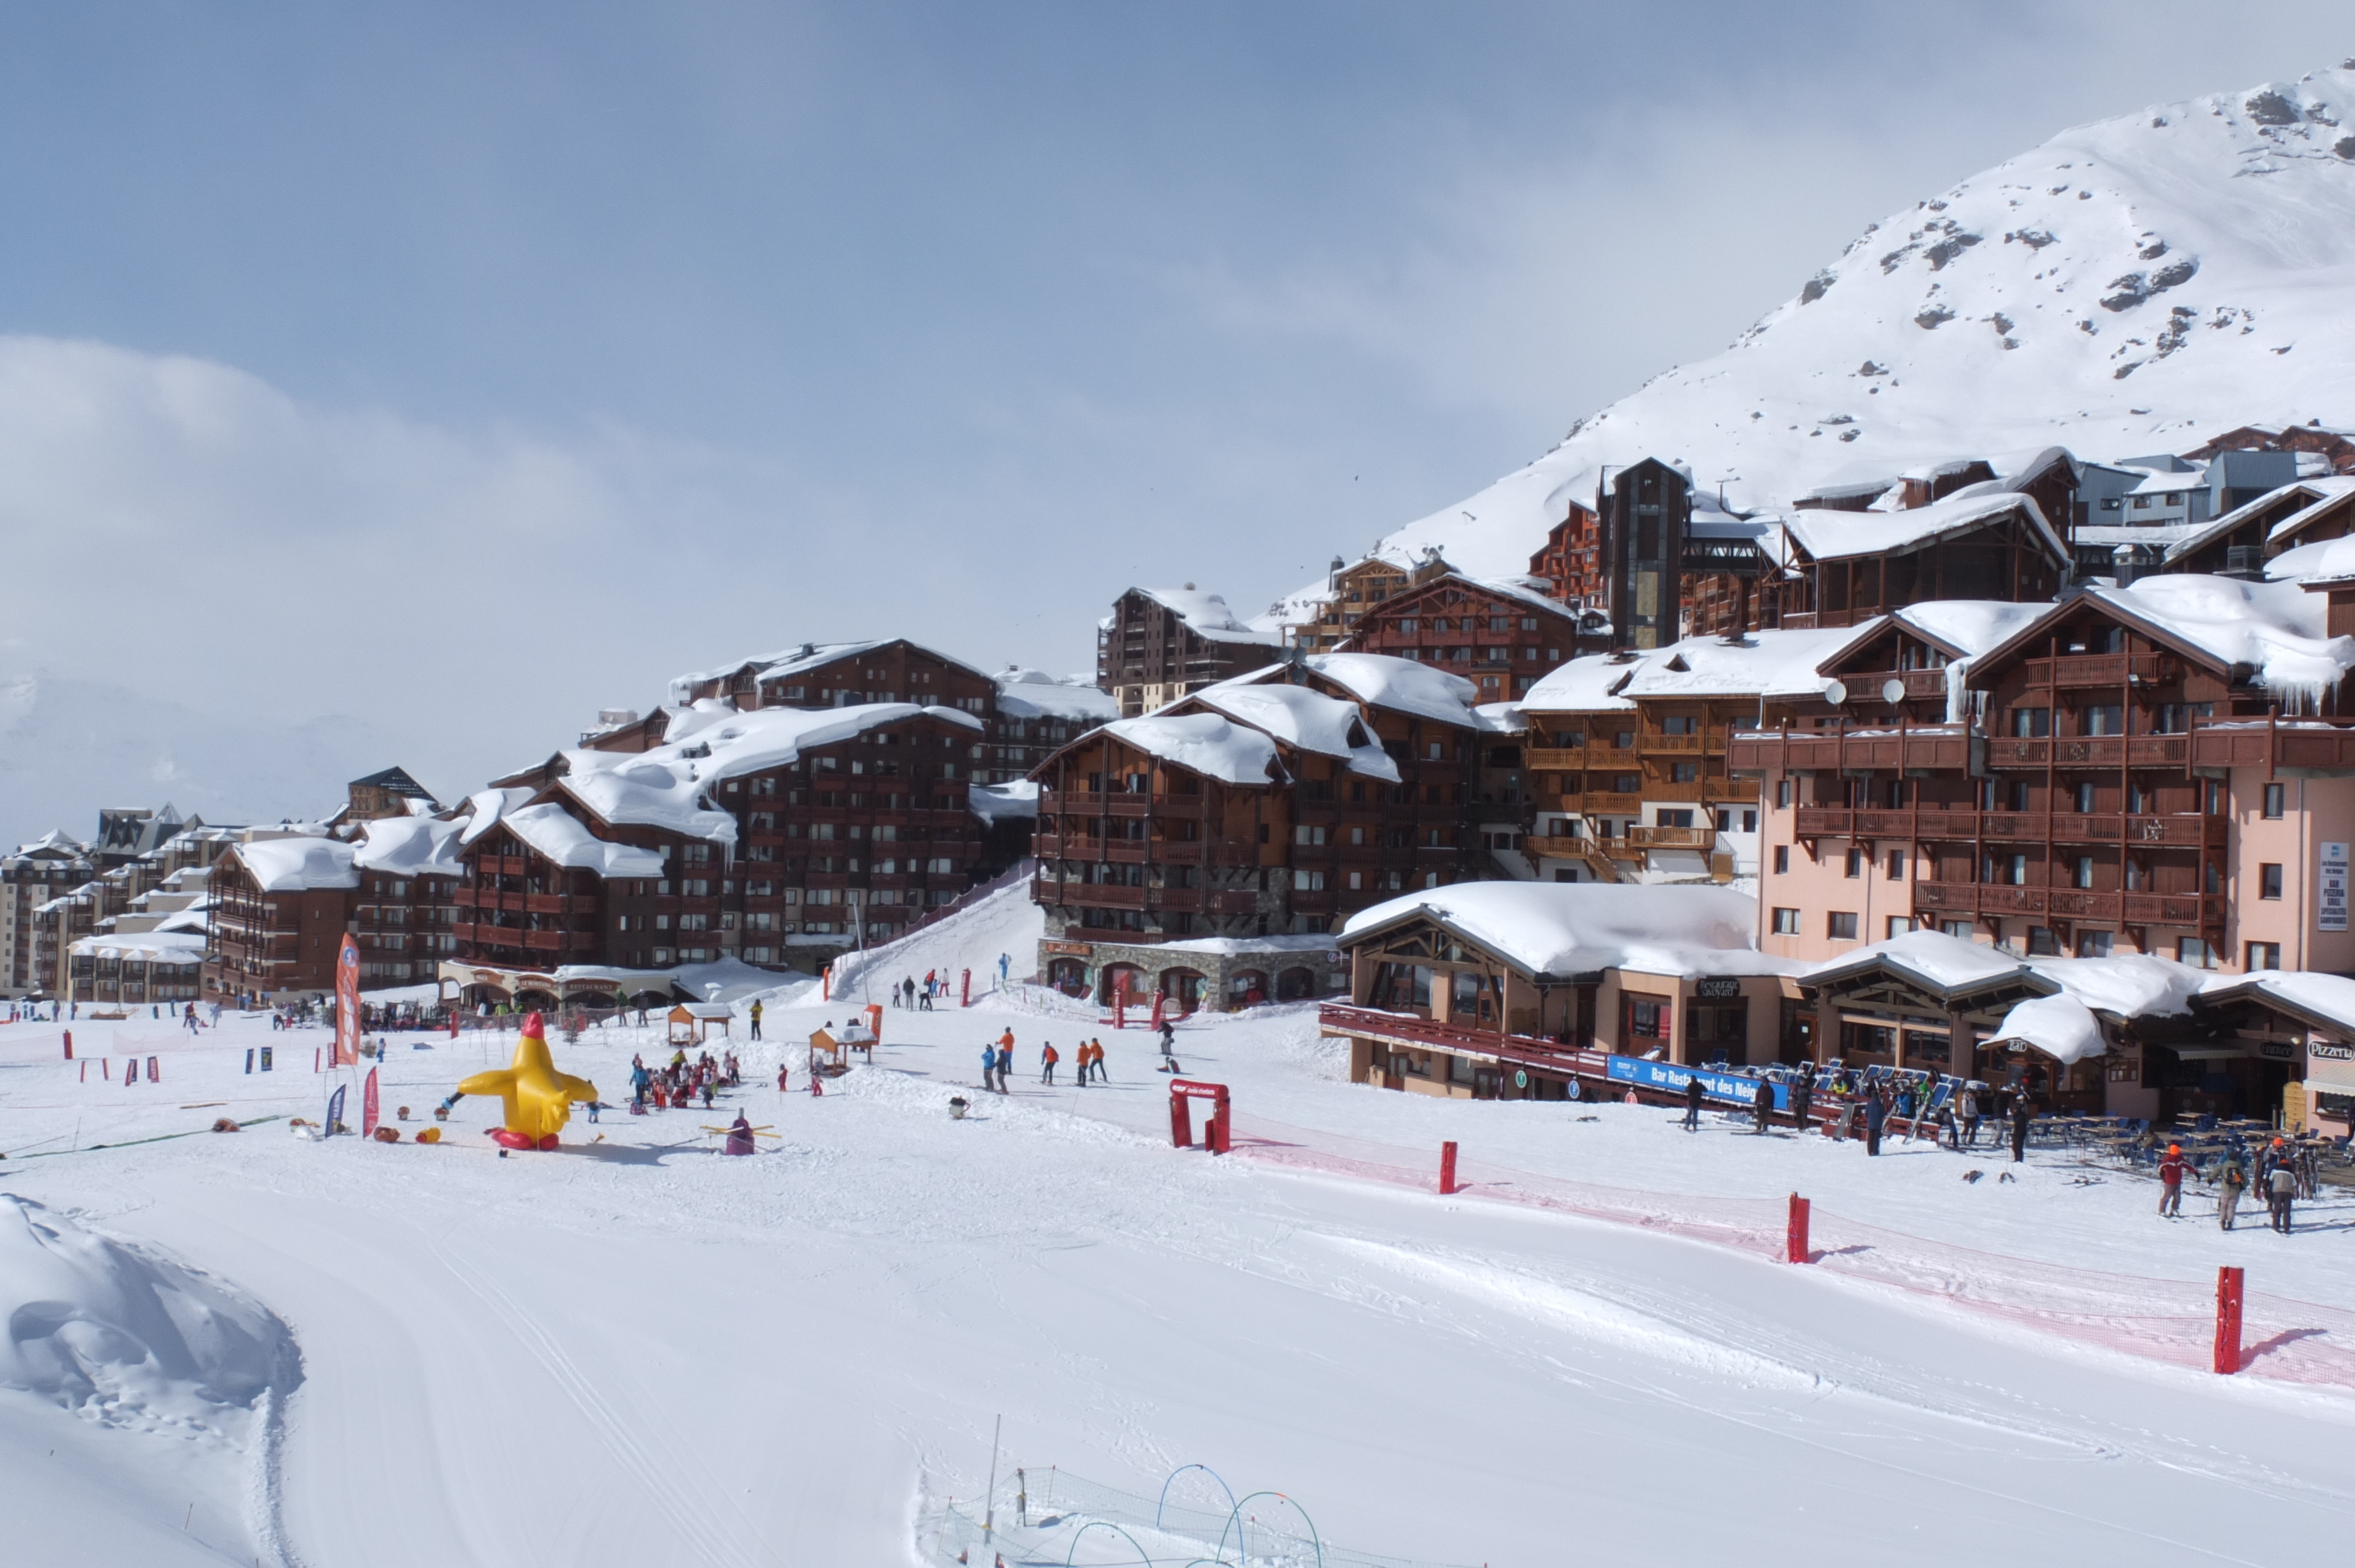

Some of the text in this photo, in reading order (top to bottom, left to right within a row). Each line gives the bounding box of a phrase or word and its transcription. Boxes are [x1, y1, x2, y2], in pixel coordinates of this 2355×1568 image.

[2311, 1042, 2353, 1058] Pizzeria
[1651, 1067, 1667, 1082] Bar
[1668, 1070, 1716, 1091] Restaant
[1717, 1079, 1733, 1095] des
[1735, 1082, 1757, 1102] Neig
